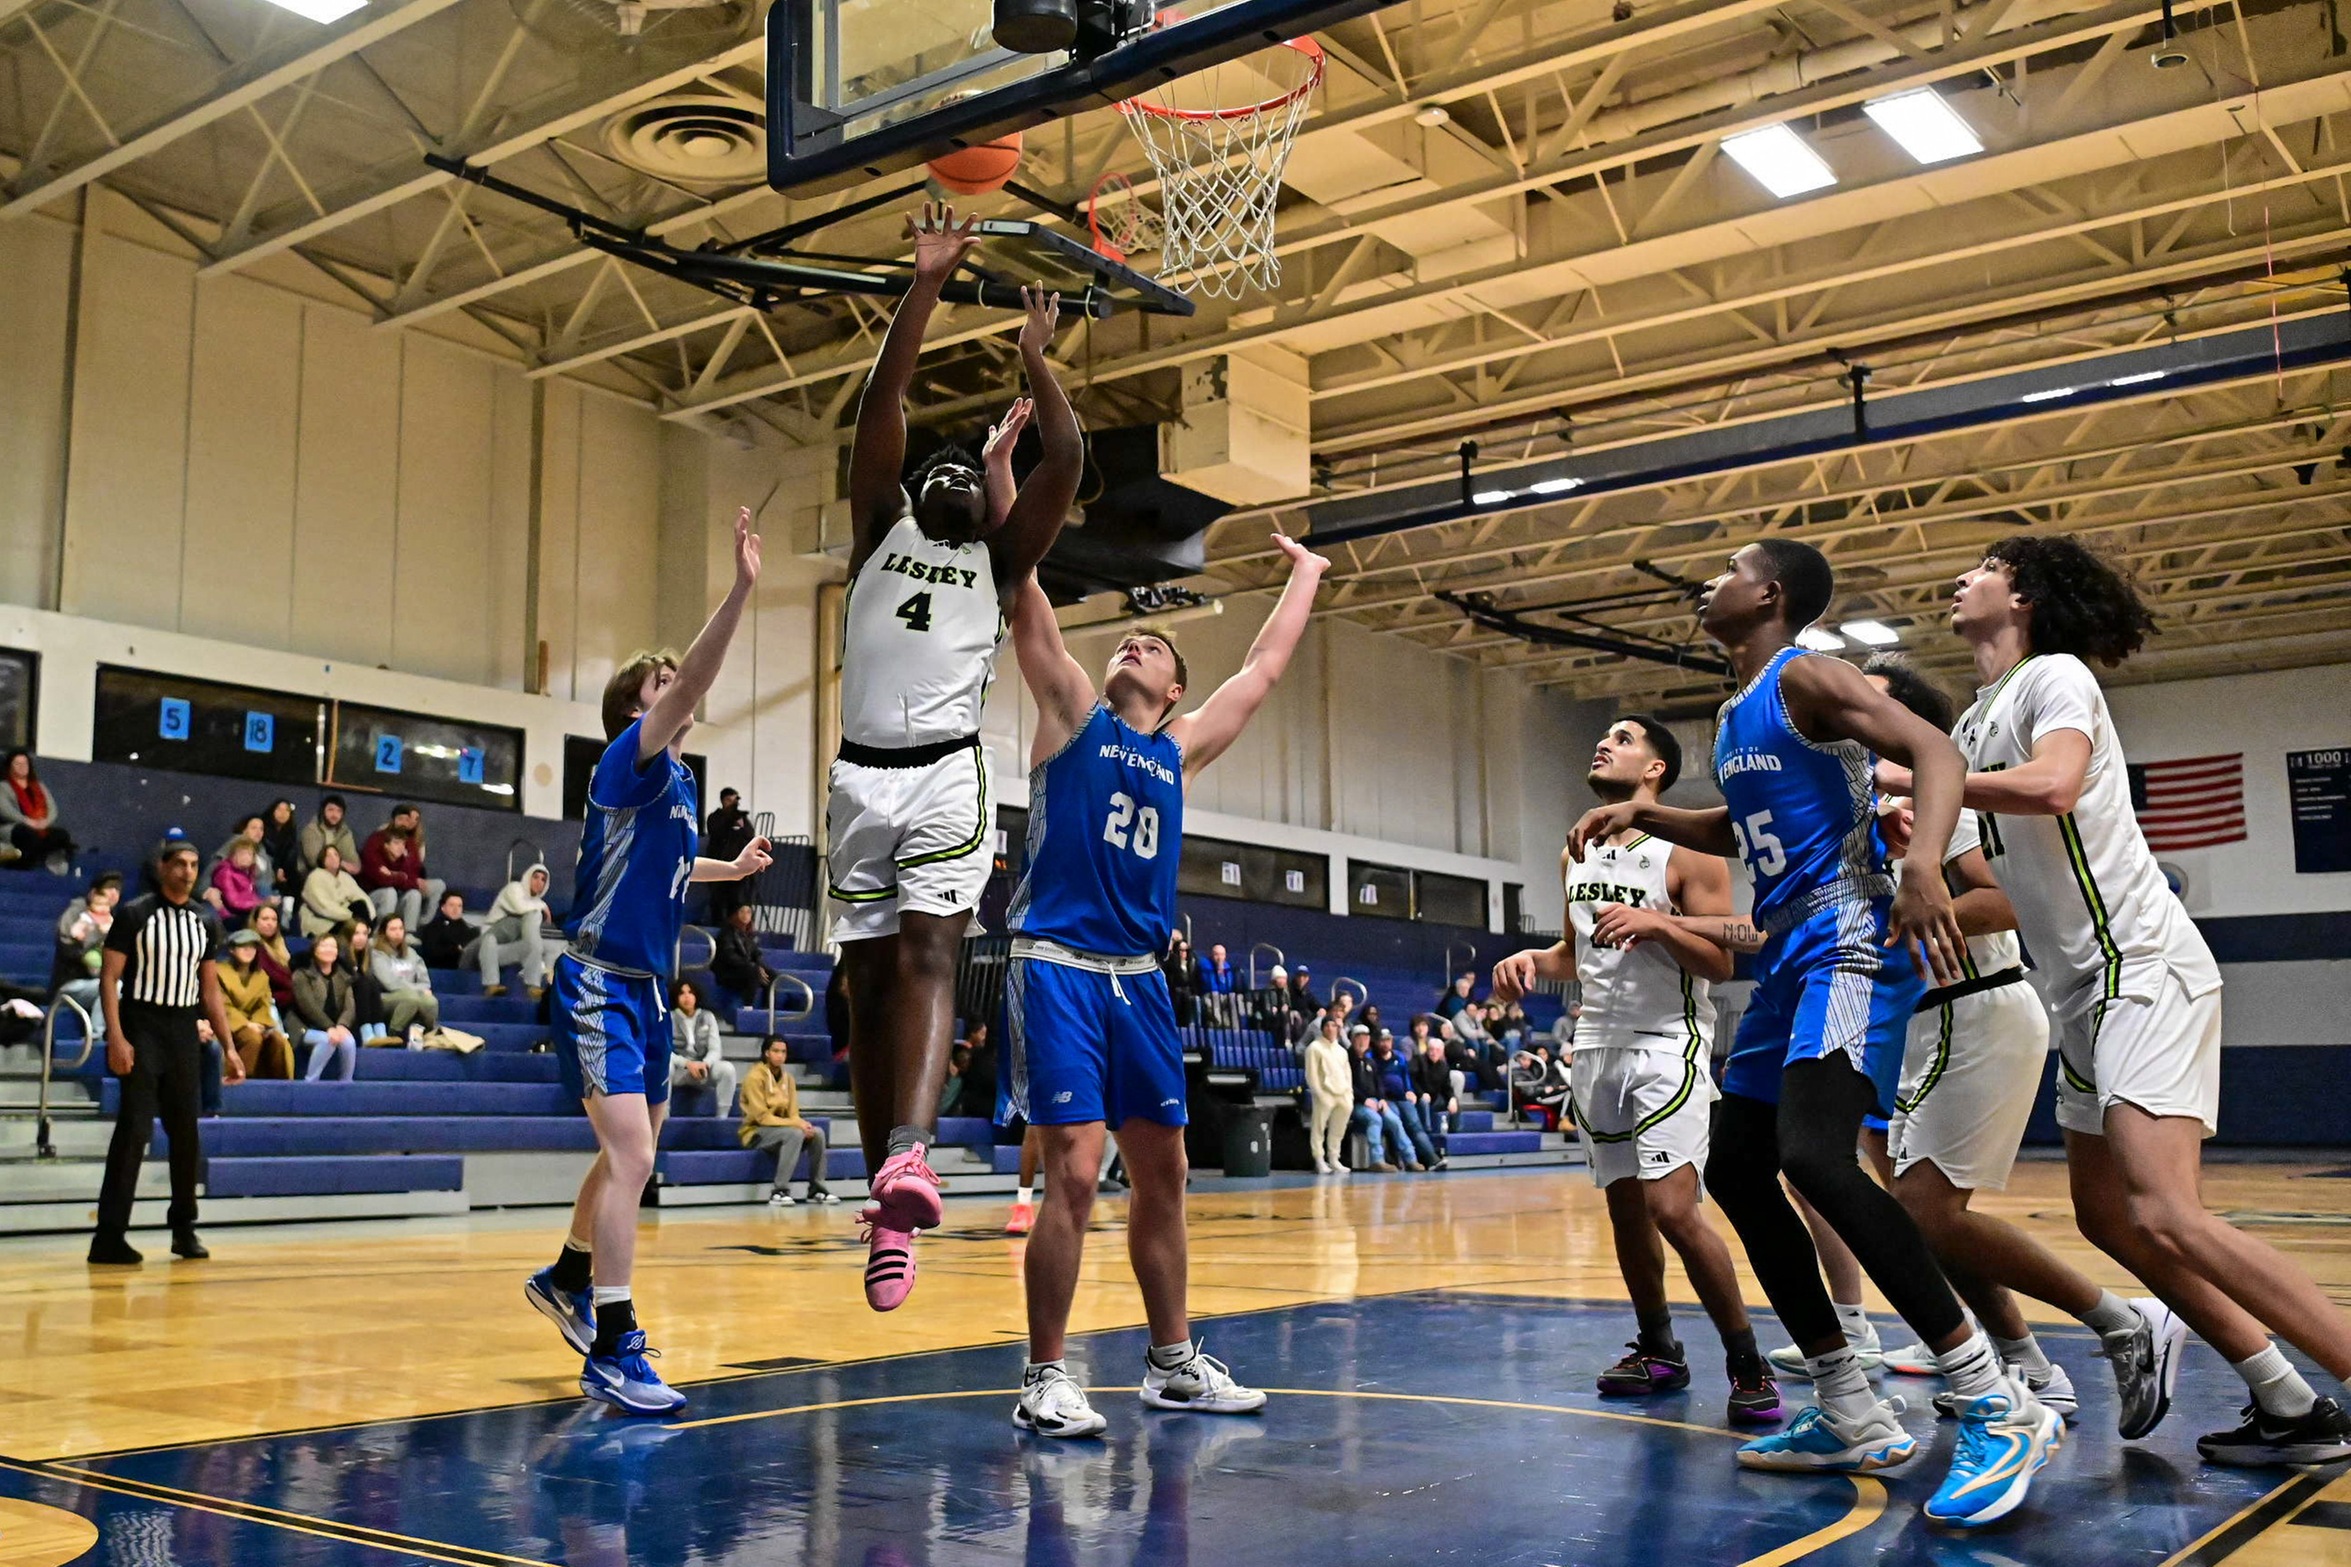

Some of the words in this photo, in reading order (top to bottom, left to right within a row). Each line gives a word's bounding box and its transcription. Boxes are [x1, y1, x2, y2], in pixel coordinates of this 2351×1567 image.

[880, 552, 977, 589] LESLEY
[895, 591, 932, 632] 4
[166, 707, 181, 731] 5
[382, 742, 395, 766] 2
[465, 755, 476, 777] 7
[2305, 751, 2341, 764] 1000
[1103, 791, 1159, 860] 20
[1568, 882, 1646, 908] LESLEY
